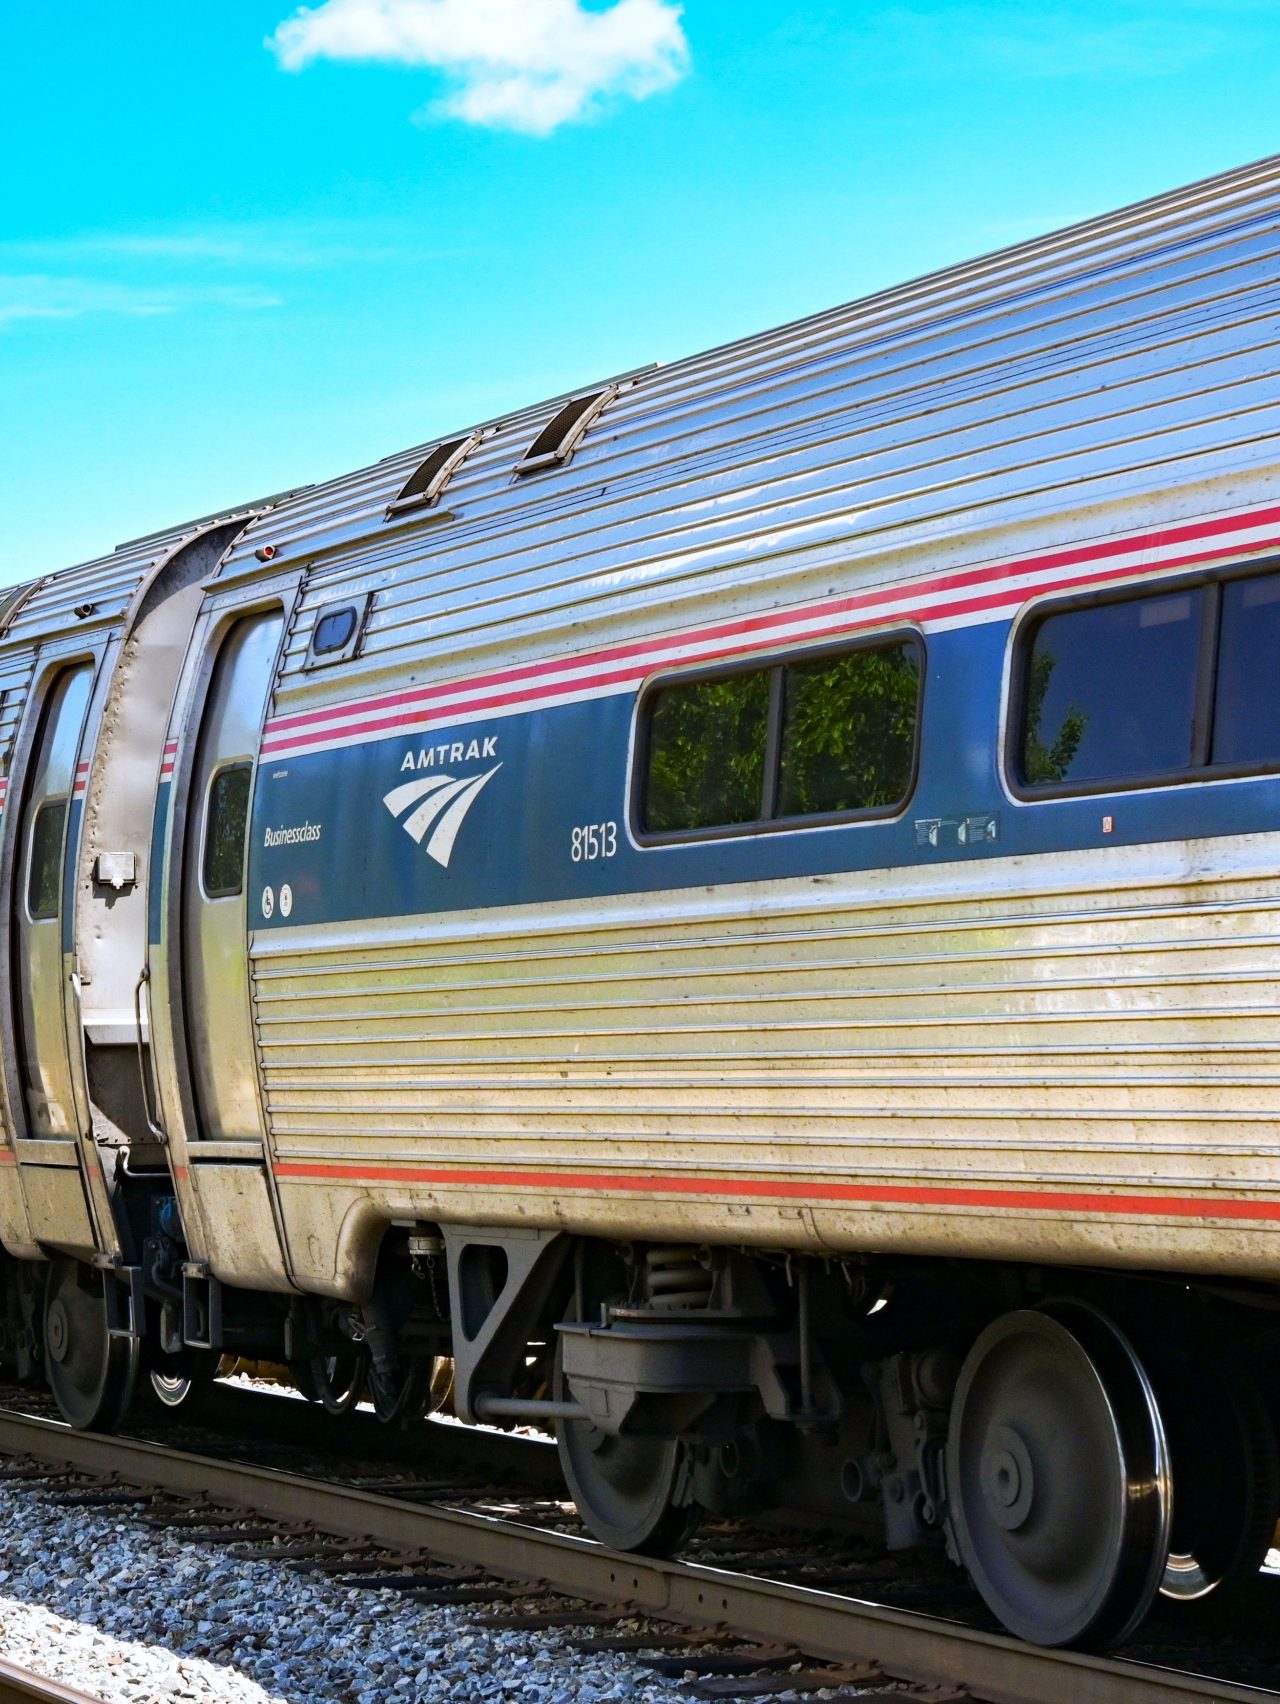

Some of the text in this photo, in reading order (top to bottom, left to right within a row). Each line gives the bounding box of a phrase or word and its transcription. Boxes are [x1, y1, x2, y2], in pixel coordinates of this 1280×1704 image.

[400, 736, 498, 772] AMTRAK
[264, 820, 322, 848] Businessclass
[571, 821, 617, 862] 81513
